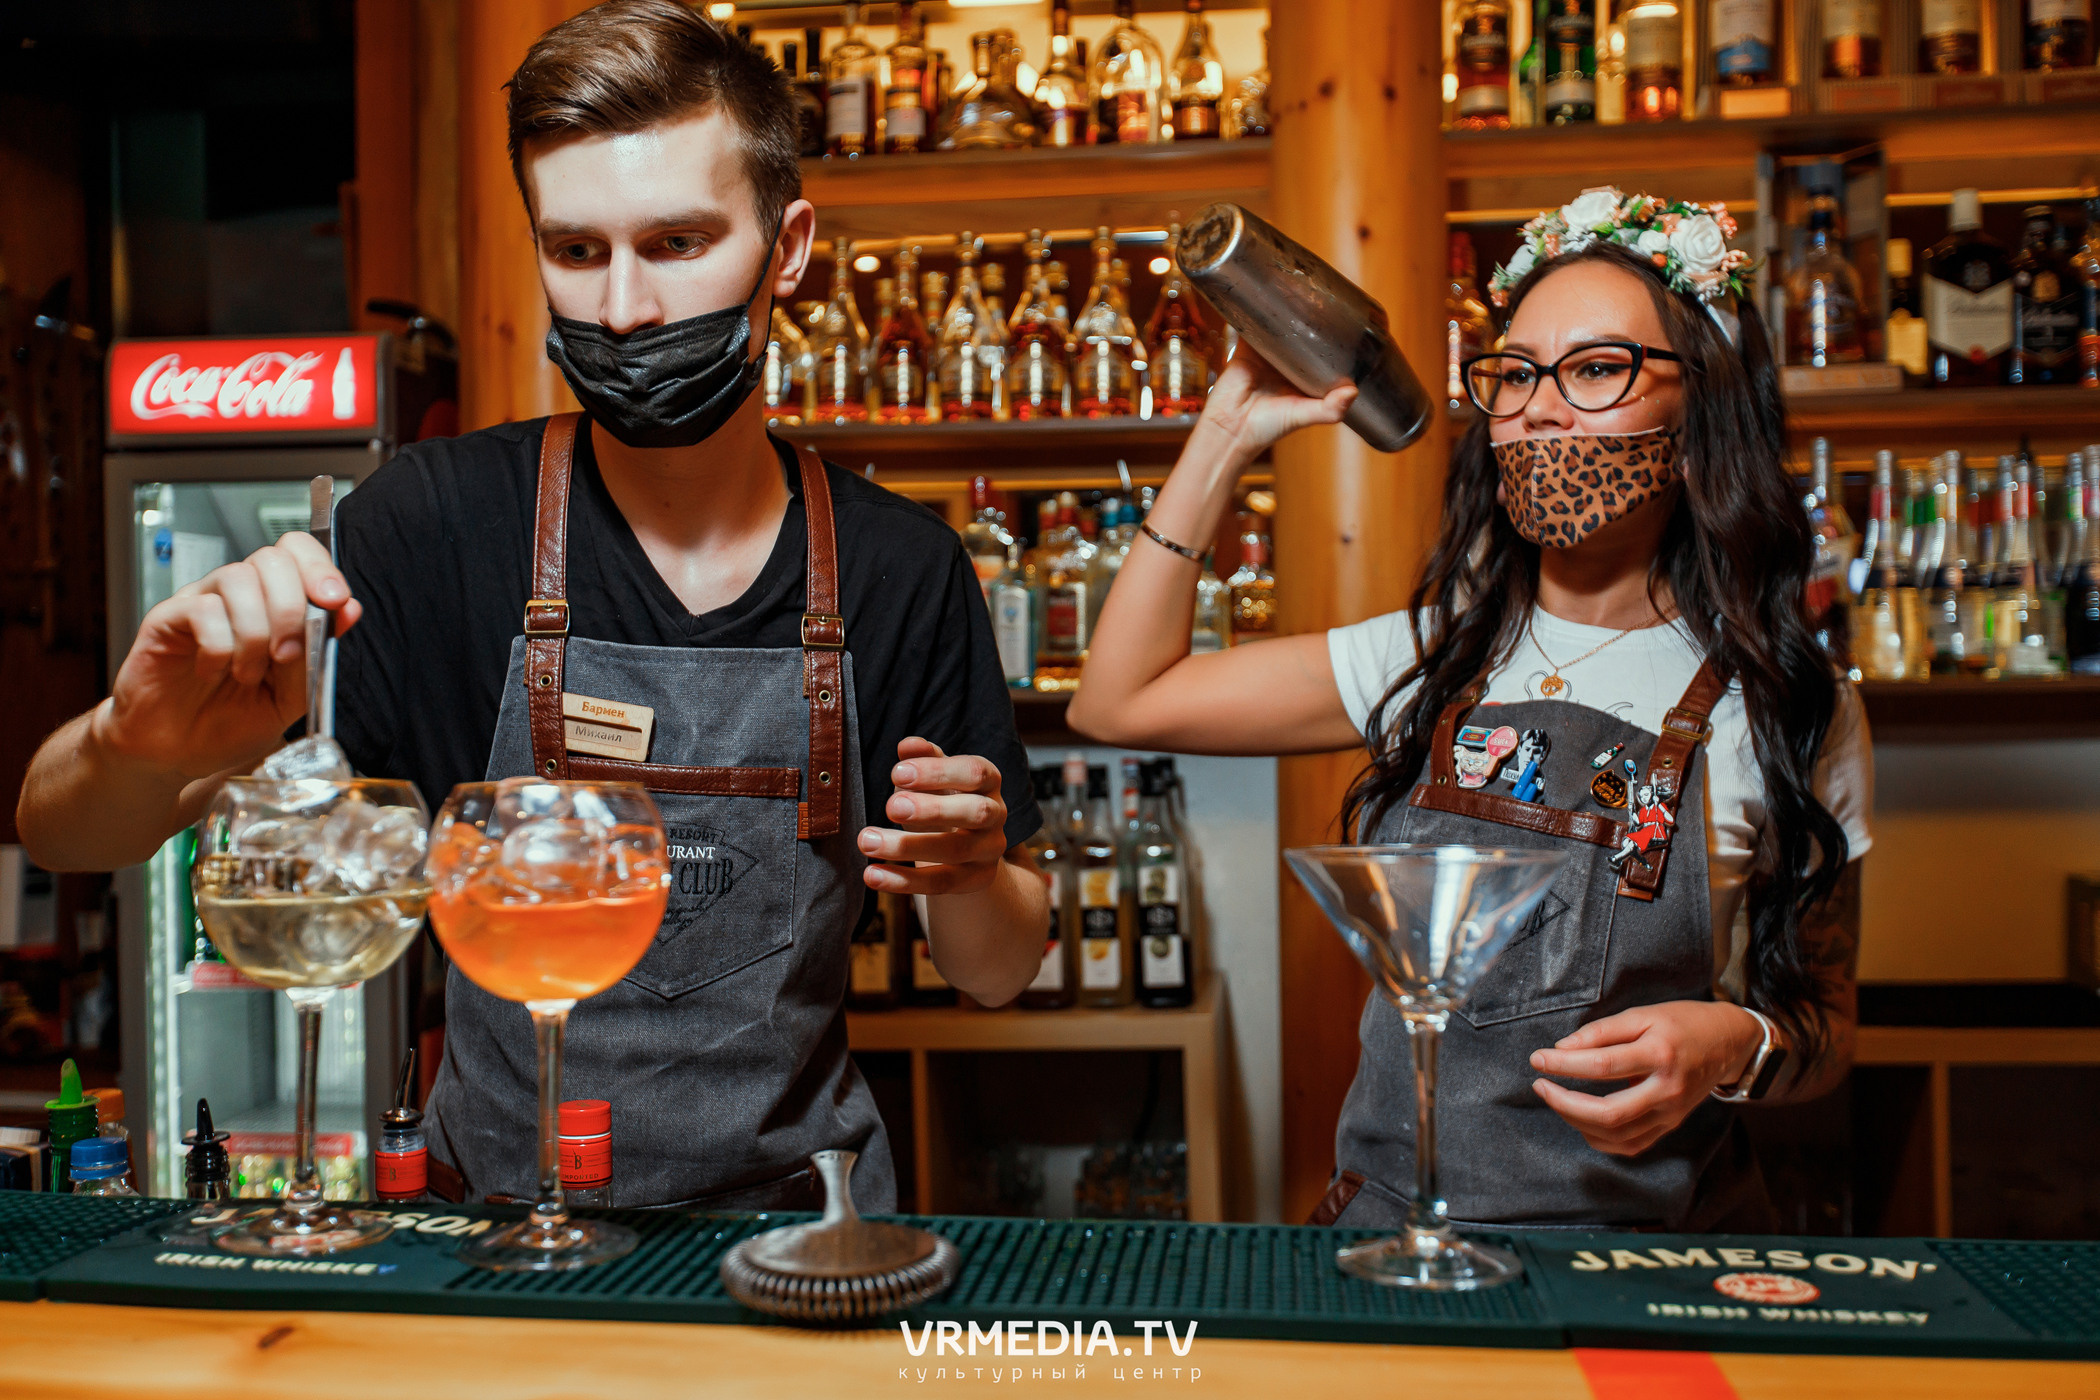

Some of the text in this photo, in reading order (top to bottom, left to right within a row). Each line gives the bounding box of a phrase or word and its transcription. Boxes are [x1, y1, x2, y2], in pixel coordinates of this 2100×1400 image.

[131, 351, 324, 420] Coca-Cola
[581, 701, 626, 719] Бармен
[575, 725, 623, 743] Михаил
[669, 827, 718, 844] RESORT
[667, 845, 716, 860] URANT
[679, 858, 734, 895] CLUB
[191, 1207, 493, 1237] JSON
[153, 1252, 247, 1269] IRISH
[1647, 1302, 1930, 1325] IRISH WHISKEY
